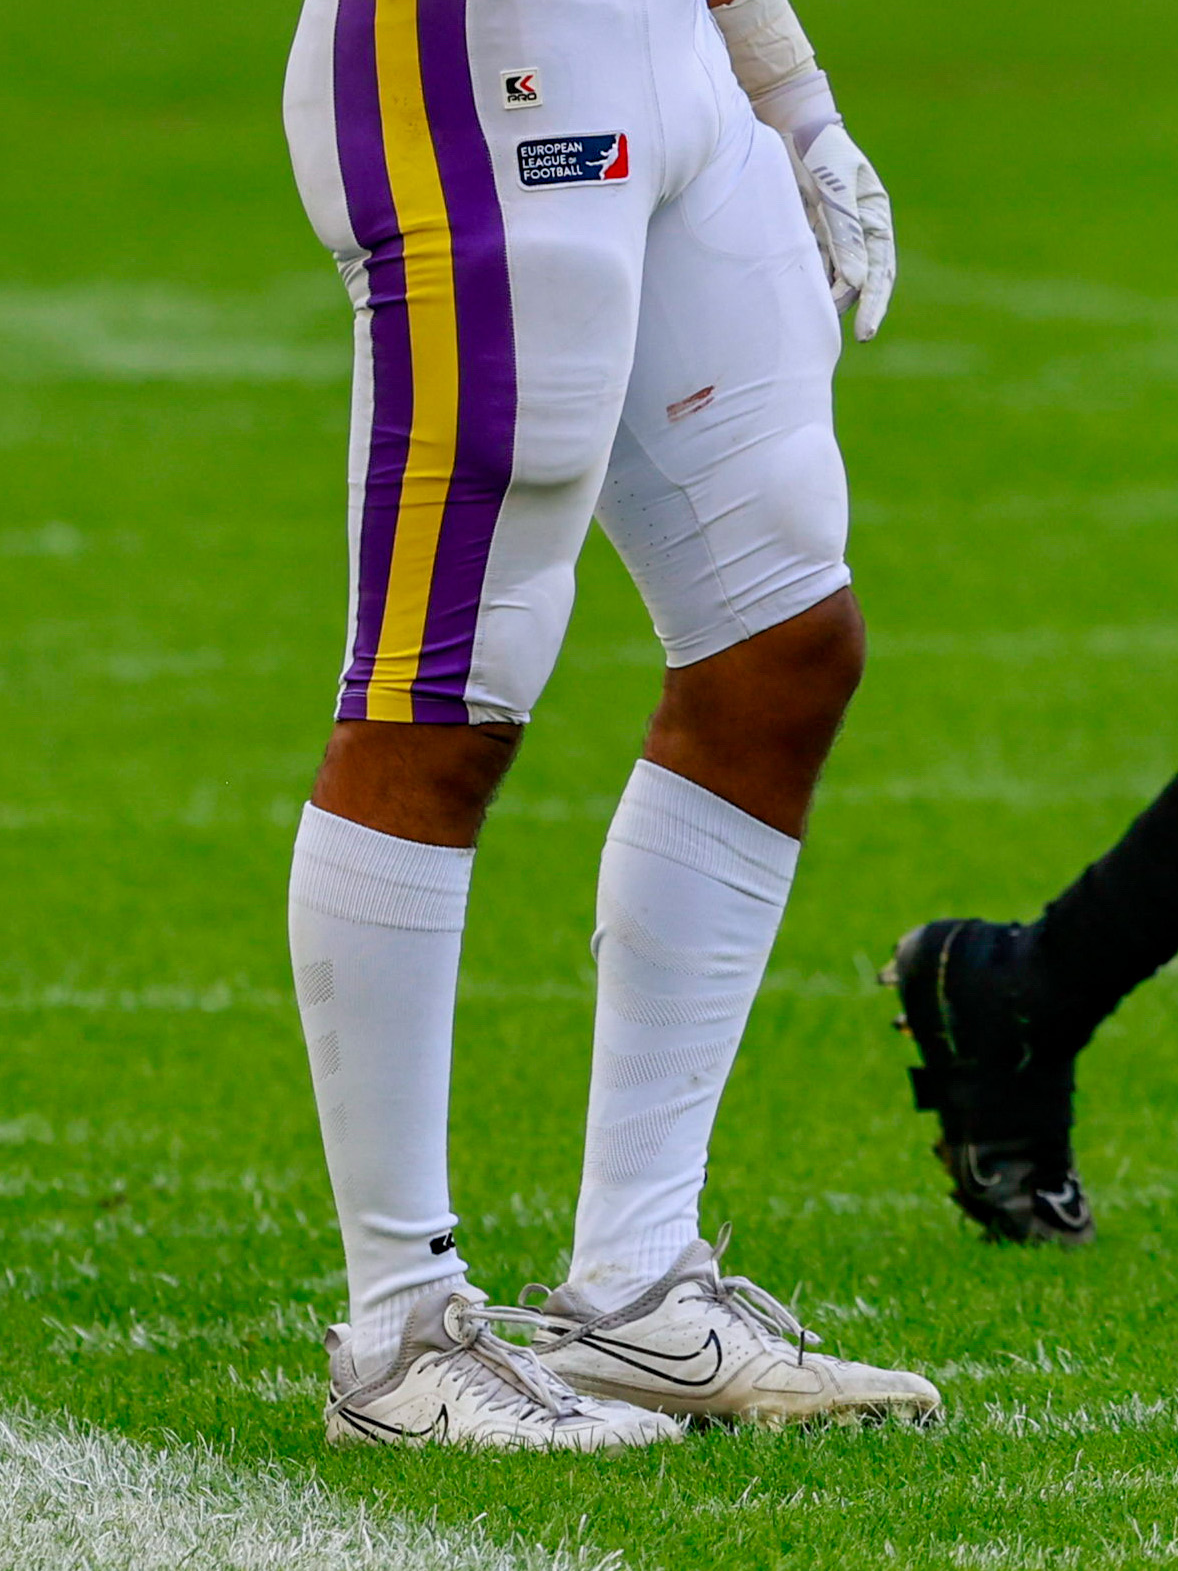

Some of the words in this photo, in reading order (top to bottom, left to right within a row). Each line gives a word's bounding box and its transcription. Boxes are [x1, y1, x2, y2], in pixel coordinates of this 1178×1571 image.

[521, 142, 583, 157] EUROPEAN
[522, 154, 566, 169] LEAGUE
[523, 165, 583, 180] FOOTBALL
